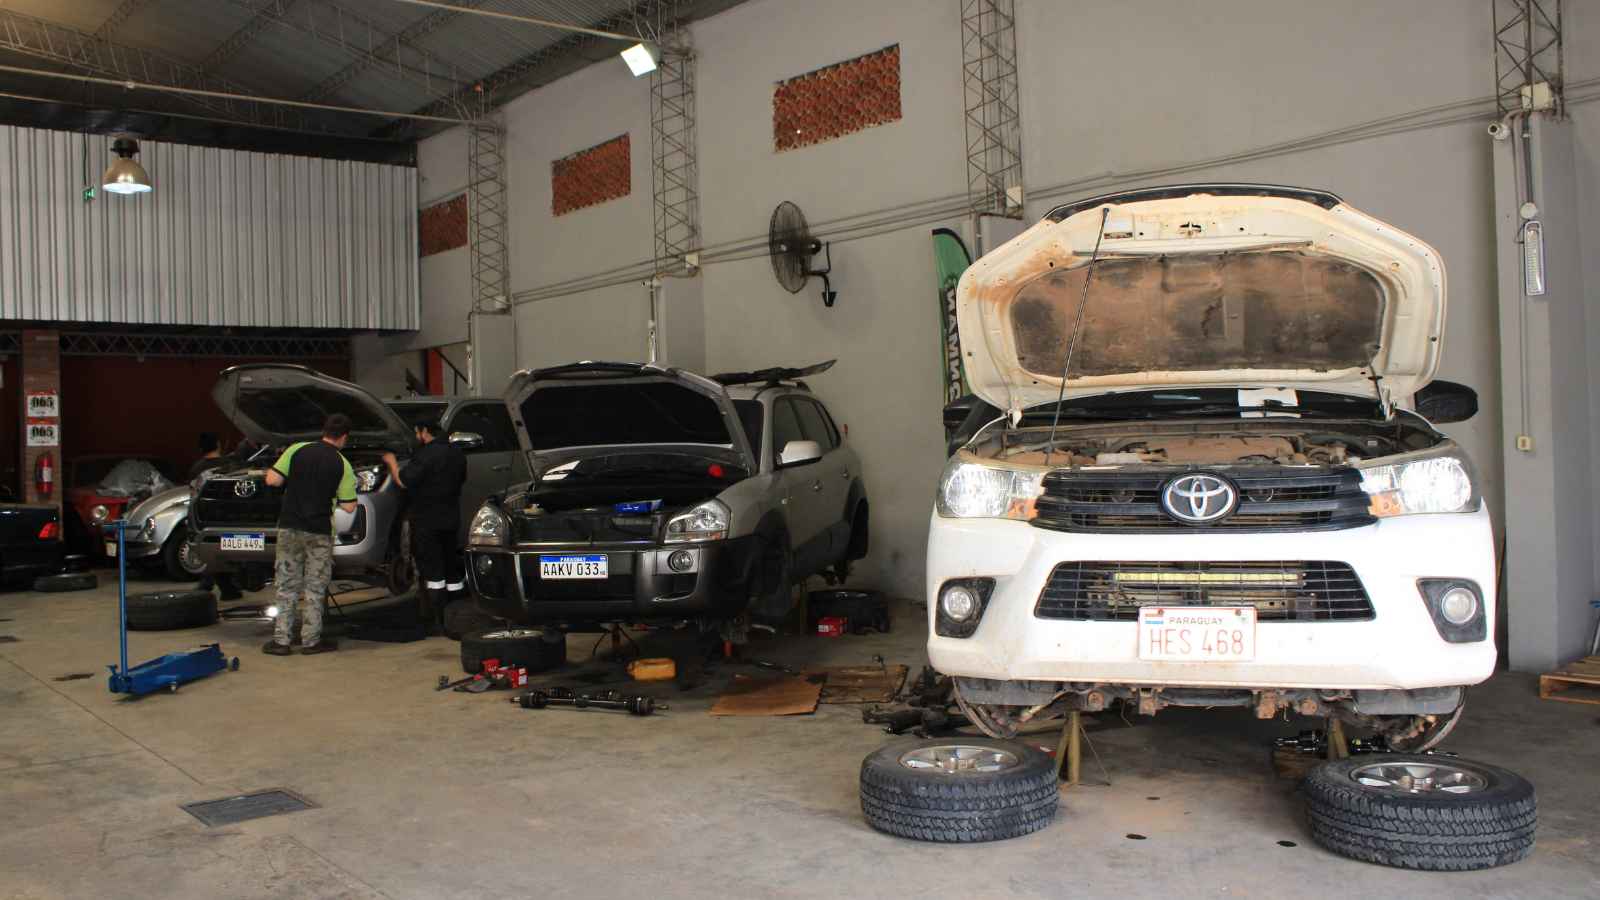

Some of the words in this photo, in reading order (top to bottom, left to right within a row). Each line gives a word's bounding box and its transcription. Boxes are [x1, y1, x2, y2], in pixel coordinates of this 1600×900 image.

[543, 563, 573, 576] AAKV
[576, 562, 599, 576] 033
[1168, 616, 1223, 625] PARAGUAY
[1150, 628, 1192, 655] HES
[1201, 628, 1244, 655] 468
